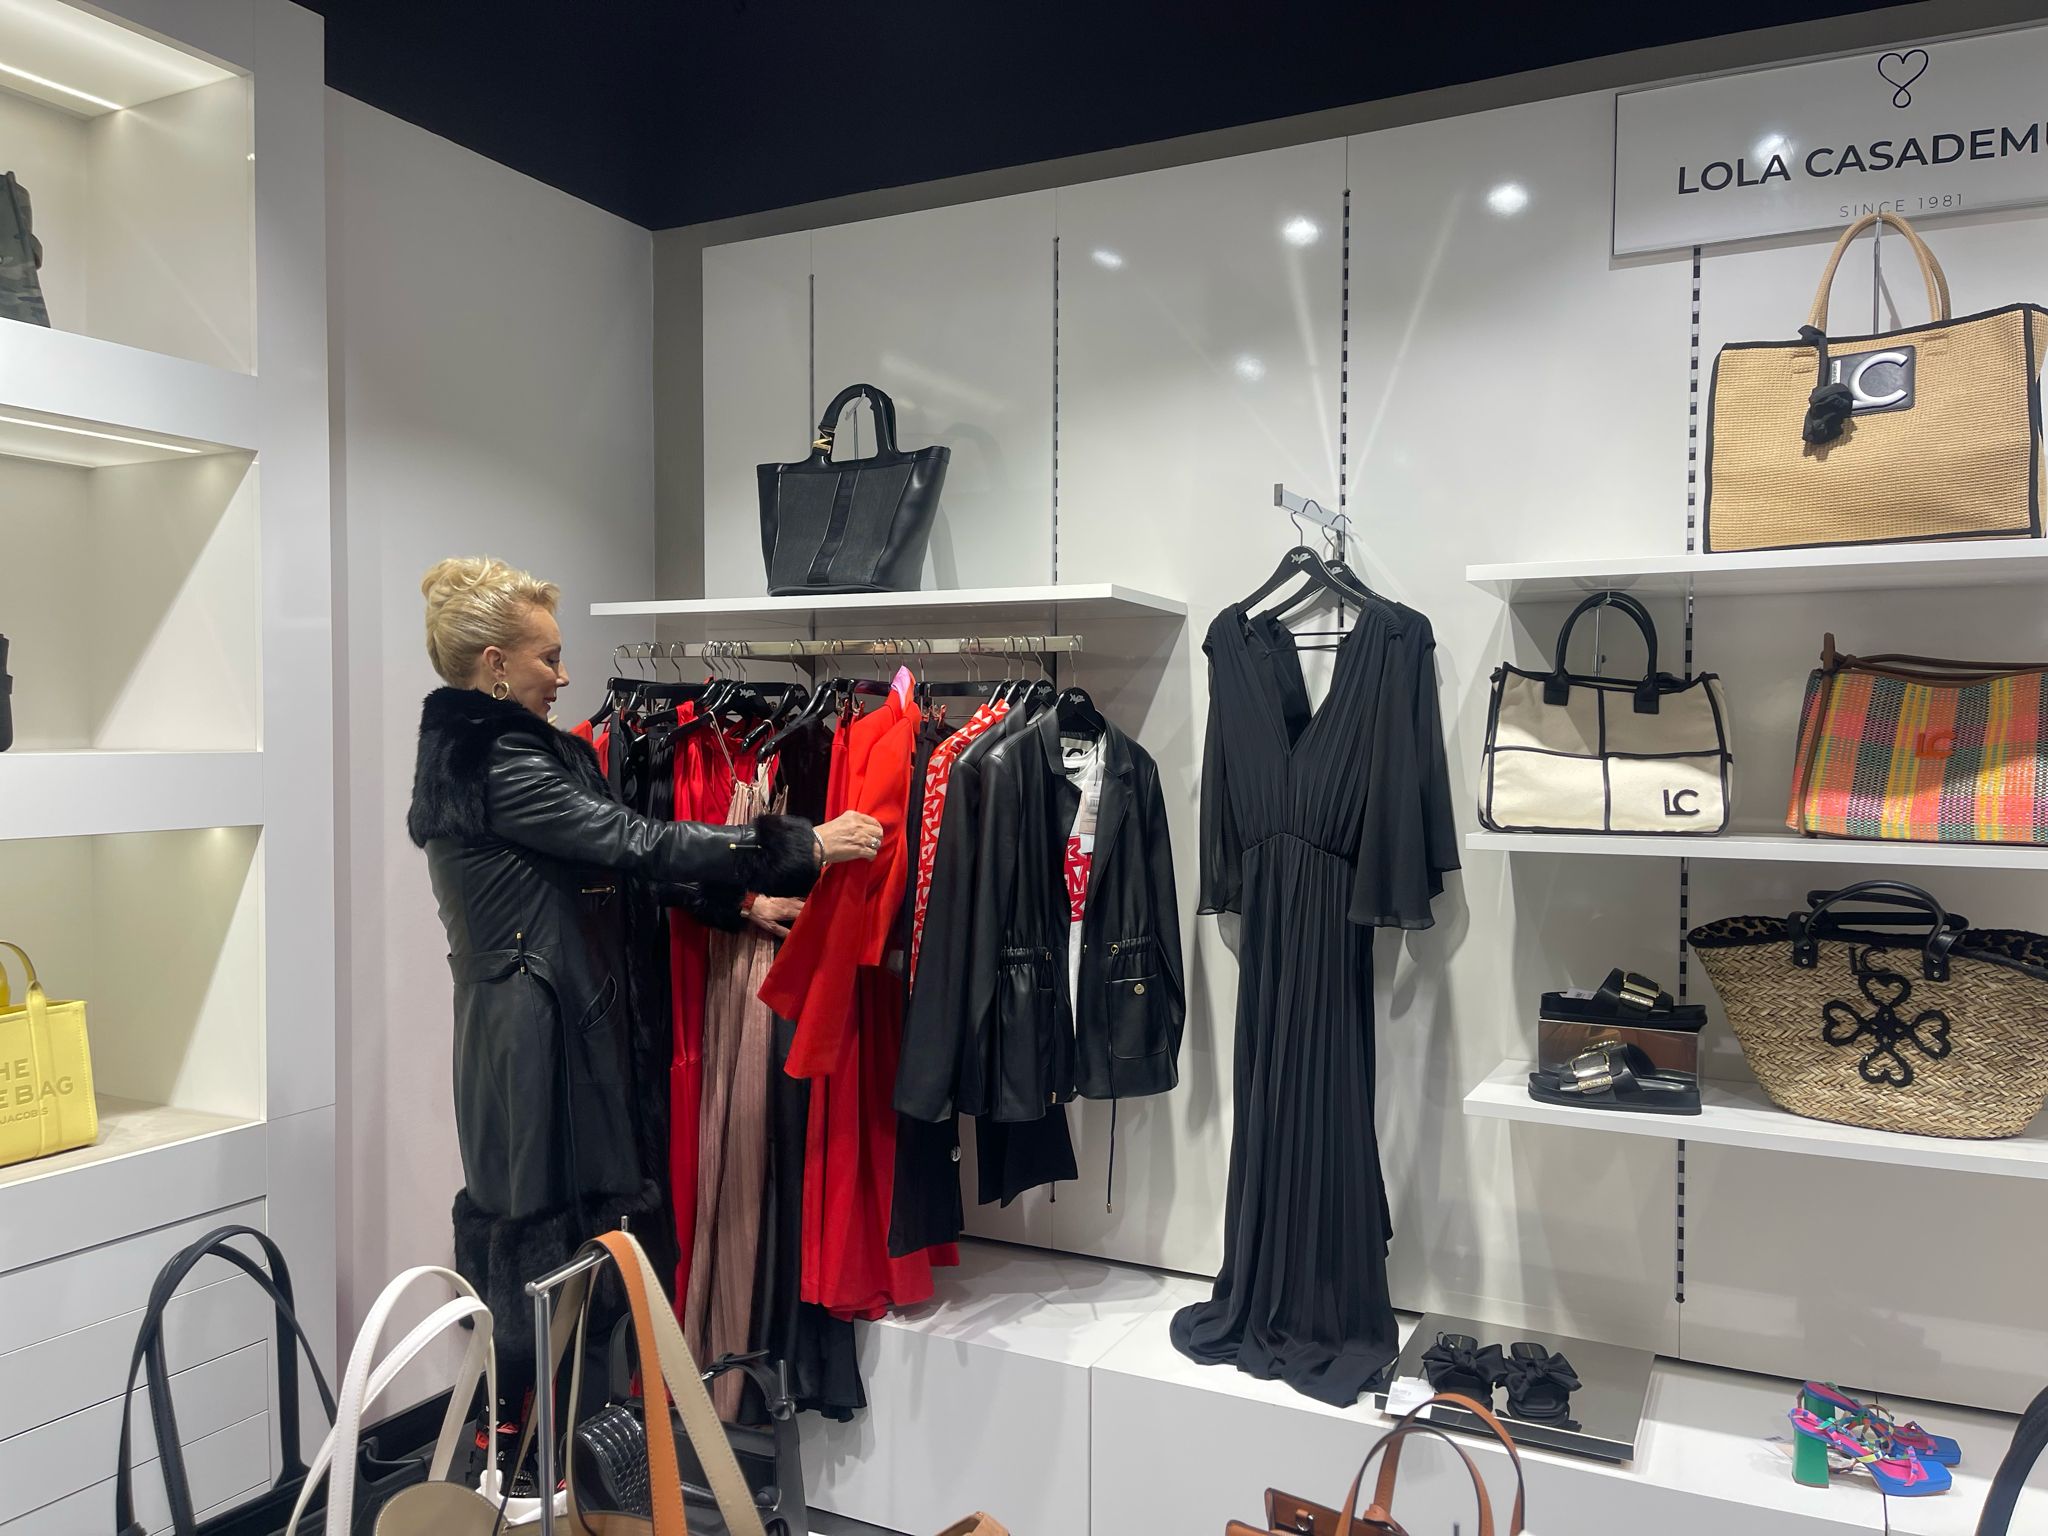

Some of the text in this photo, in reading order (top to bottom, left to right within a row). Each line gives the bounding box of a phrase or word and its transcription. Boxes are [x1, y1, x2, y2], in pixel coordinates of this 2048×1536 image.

[1677, 121, 2048, 194] LOLA CASADEM
[1839, 193, 1963, 218] SINCE 1981
[1663, 788, 1701, 816] LC
[15, 1075, 74, 1106] BAG
